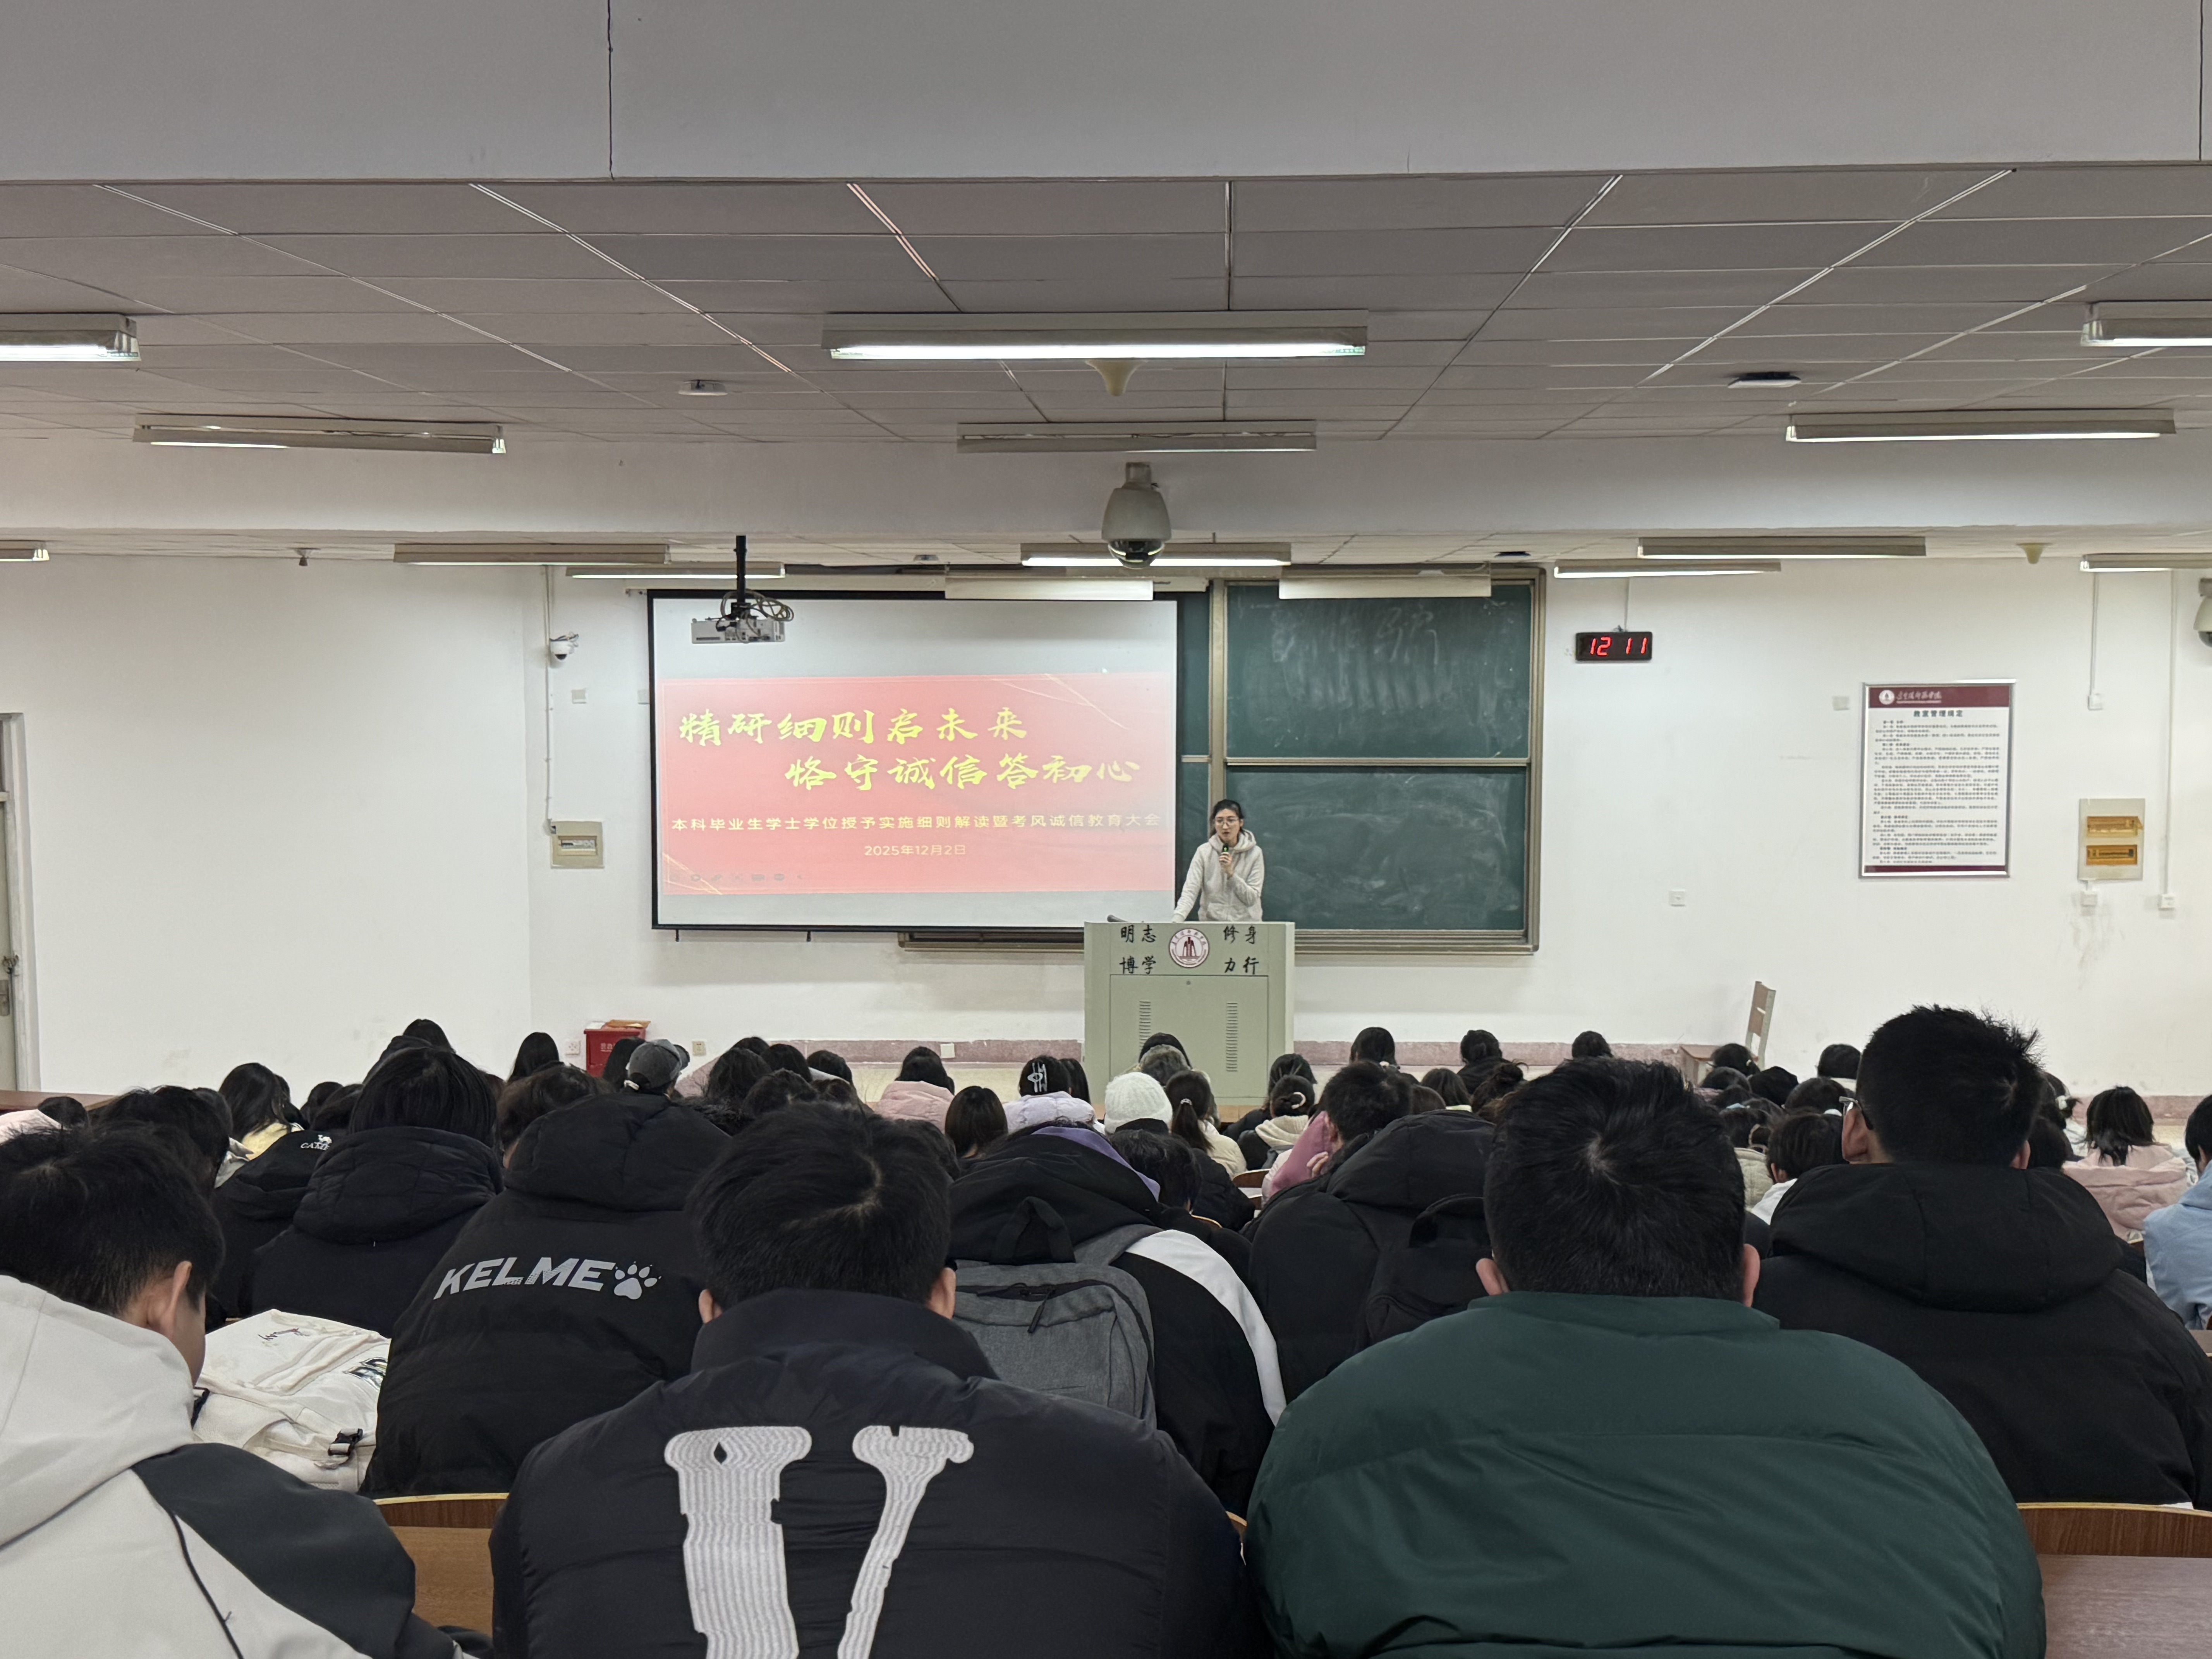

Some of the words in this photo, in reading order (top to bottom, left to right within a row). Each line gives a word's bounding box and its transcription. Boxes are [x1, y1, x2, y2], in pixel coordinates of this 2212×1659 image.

[1590, 637, 1612, 656] 12
[1626, 637, 1647, 654] 11
[679, 708, 1027, 746] 精研细则启未来
[785, 752, 1140, 790] 恪守诚信答初心
[671, 813, 1161, 831] 本科毕业生学士学位授予实施细则解读暨考风诚信教育大会
[864, 844, 967, 856] 2025年12月2日
[1121, 924, 1157, 943] 明志
[1223, 925, 1257, 944] 修身
[1119, 955, 1157, 975] 博学
[1224, 956, 1259, 975] 力行
[433, 1257, 616, 1300] KELME
